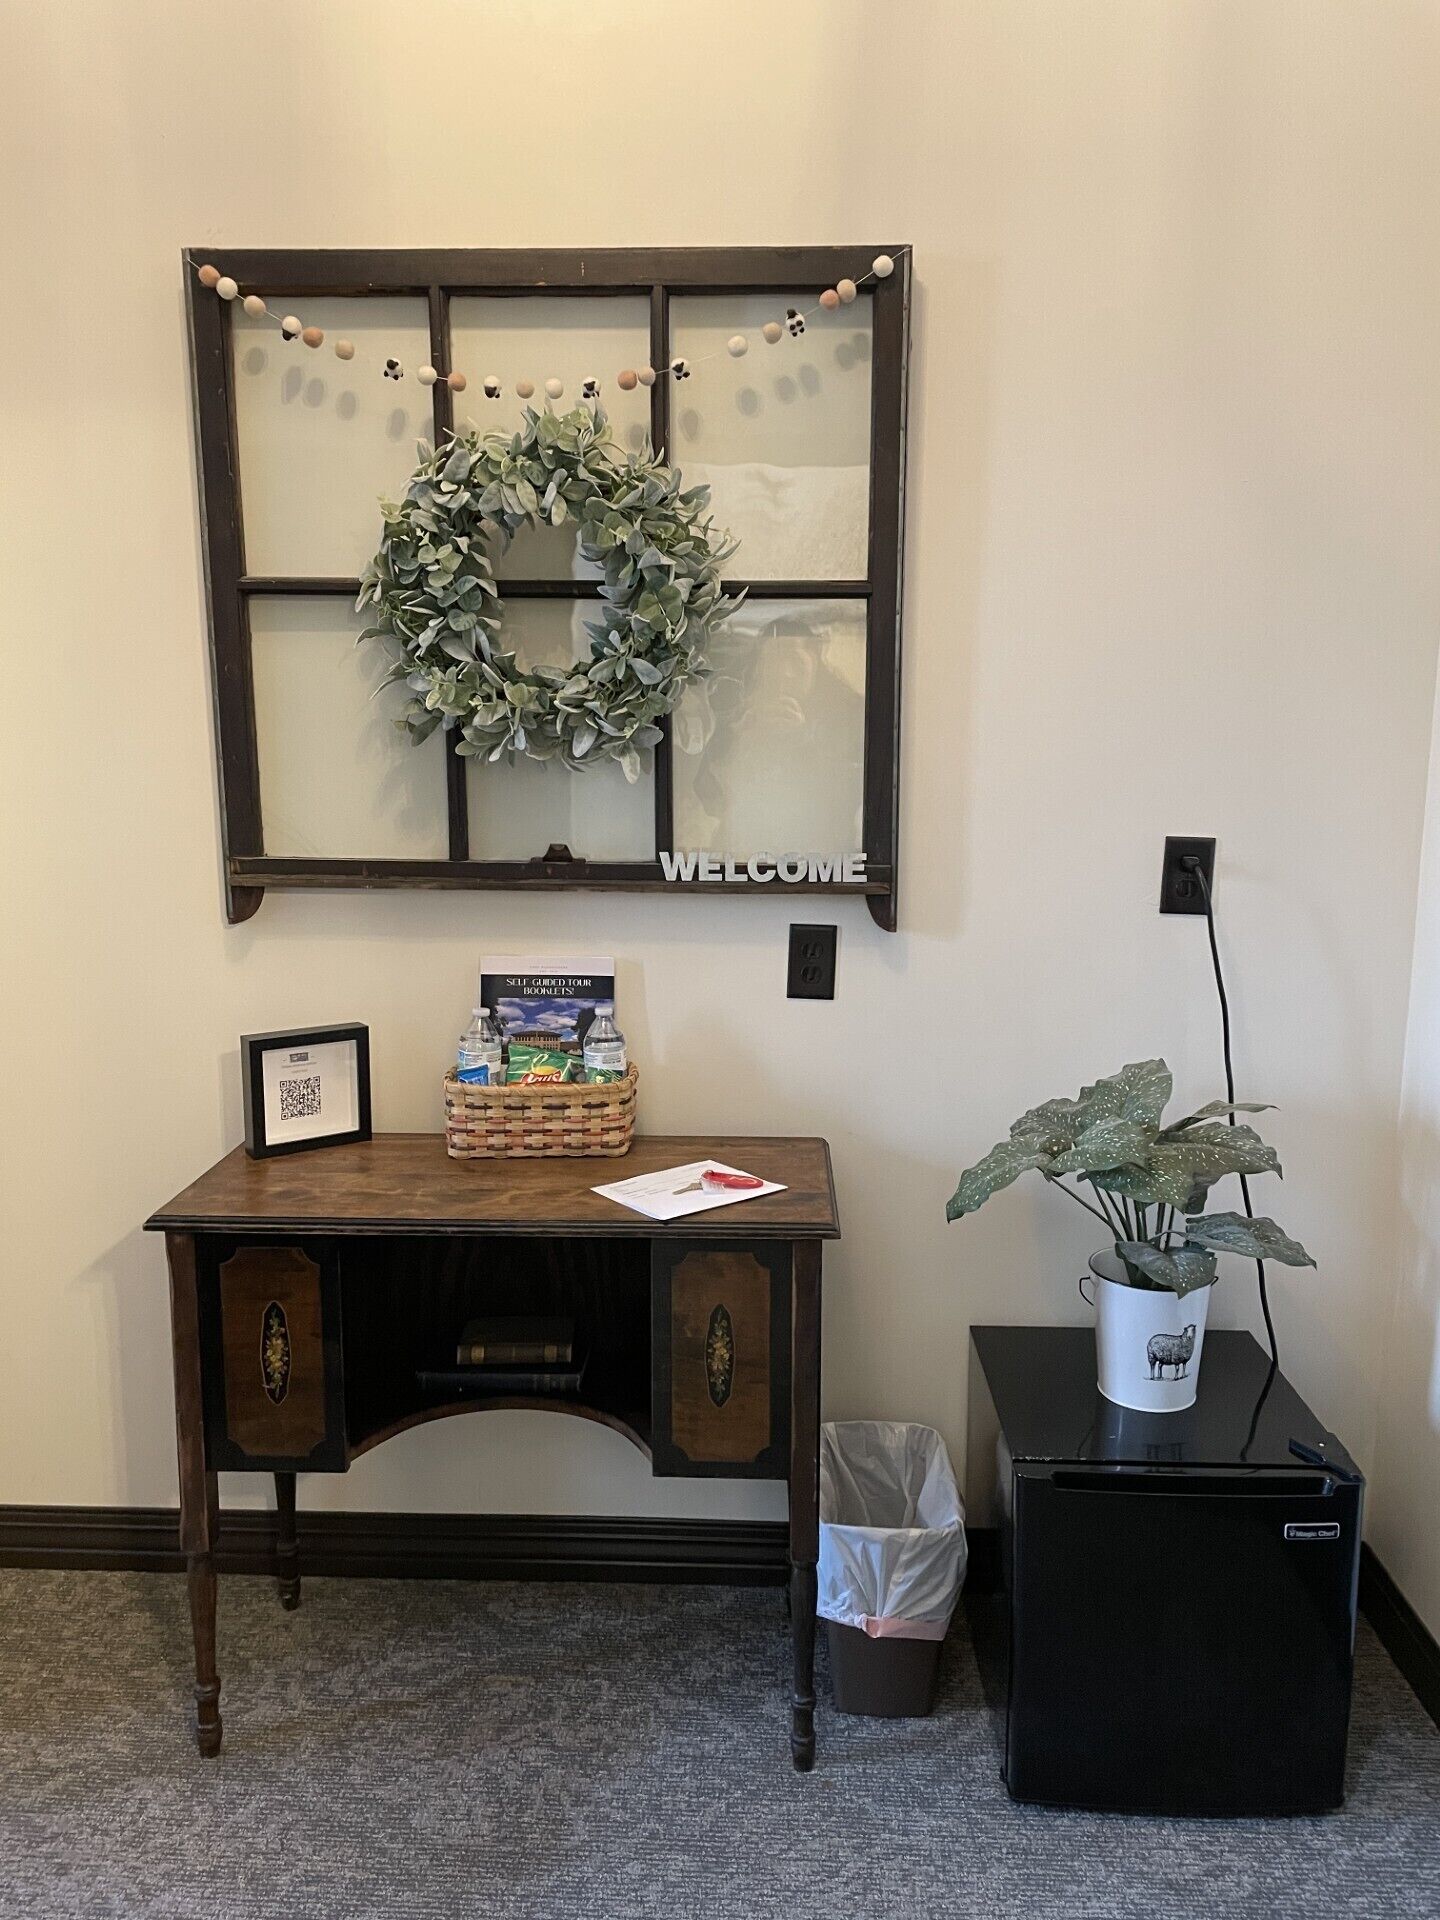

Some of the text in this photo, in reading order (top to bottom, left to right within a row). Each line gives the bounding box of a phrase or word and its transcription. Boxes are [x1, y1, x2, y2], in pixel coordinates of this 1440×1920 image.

[659, 851, 868, 883] WELCOME
[506, 978, 592, 987] SELF GUIDED TOUR
[523, 986, 575, 996] BOOKLETS!
[1295, 1530, 1317, 1538] Magic
